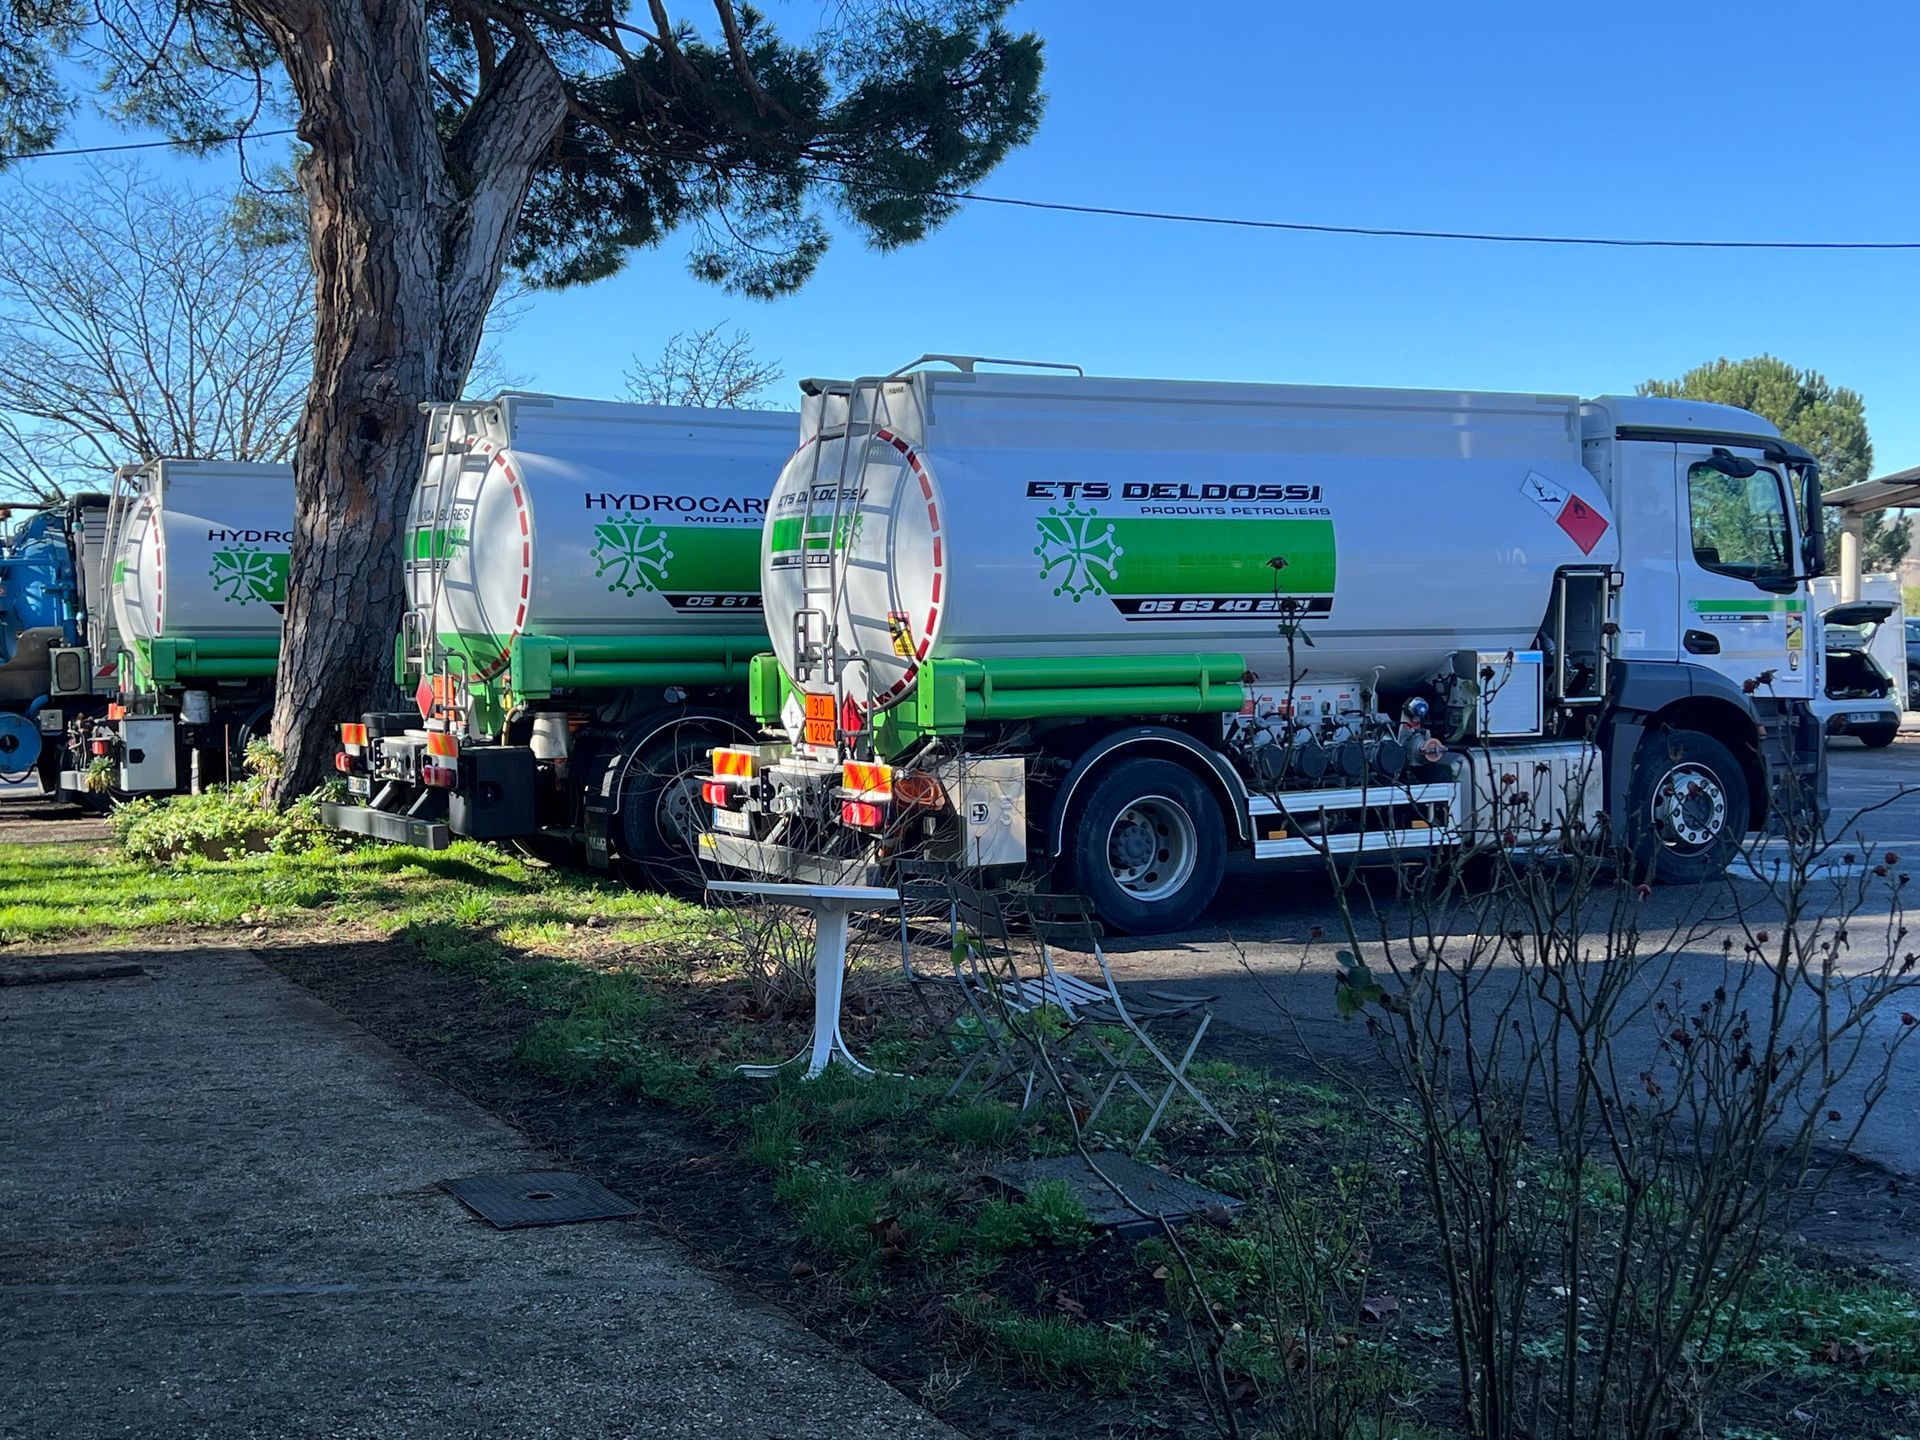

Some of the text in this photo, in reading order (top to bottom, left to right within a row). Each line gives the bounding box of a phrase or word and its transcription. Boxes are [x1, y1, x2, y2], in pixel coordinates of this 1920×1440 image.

[1026, 480, 1324, 503] ETS DELDOSSI
[585, 492, 771, 514] HYDROCAR
[1140, 506, 1331, 516] PRODUITS PETROLIERS
[687, 597, 715, 606] 05
[721, 597, 747, 606] 61
[1138, 600, 1176, 613] 05
[1179, 600, 1215, 612] 63
[1218, 600, 1253, 612] 40
[814, 698, 825, 717] 30
[809, 722, 832, 742] 1202
